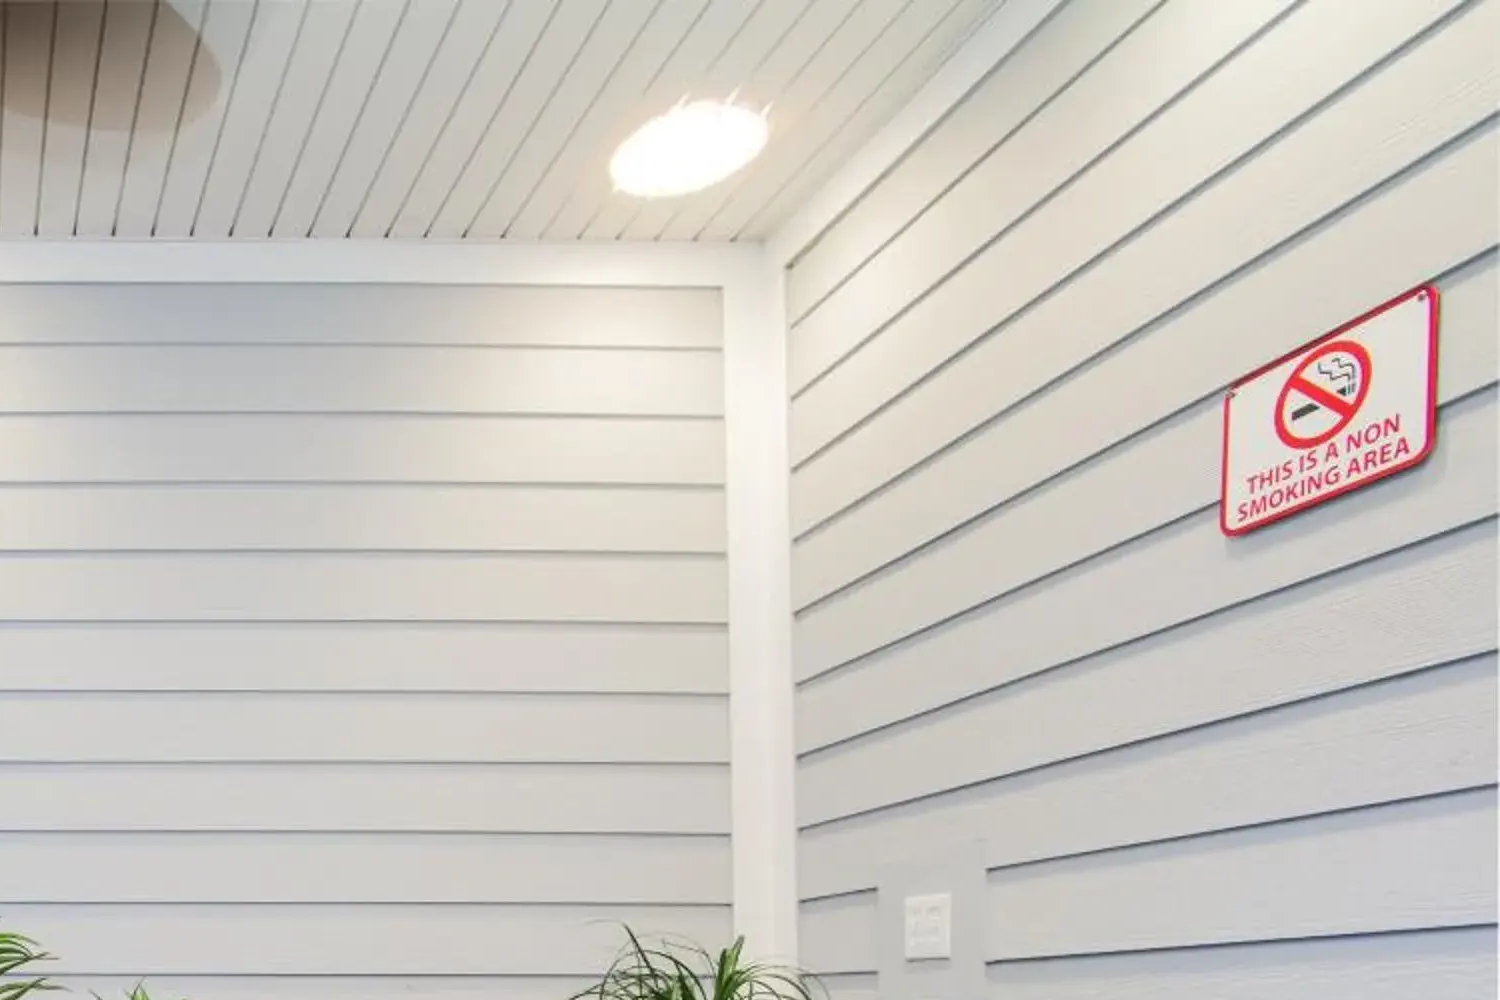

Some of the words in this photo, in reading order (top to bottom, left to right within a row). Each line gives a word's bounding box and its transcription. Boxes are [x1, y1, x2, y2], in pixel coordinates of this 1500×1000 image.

[1237, 465, 1341, 522] SMOKING
[1346, 437, 1410, 478] AREA
[1246, 459, 1293, 495] THIS
[1299, 450, 1317, 473] IS
[1324, 442, 1339, 463] A
[1346, 413, 1401, 453] NON
